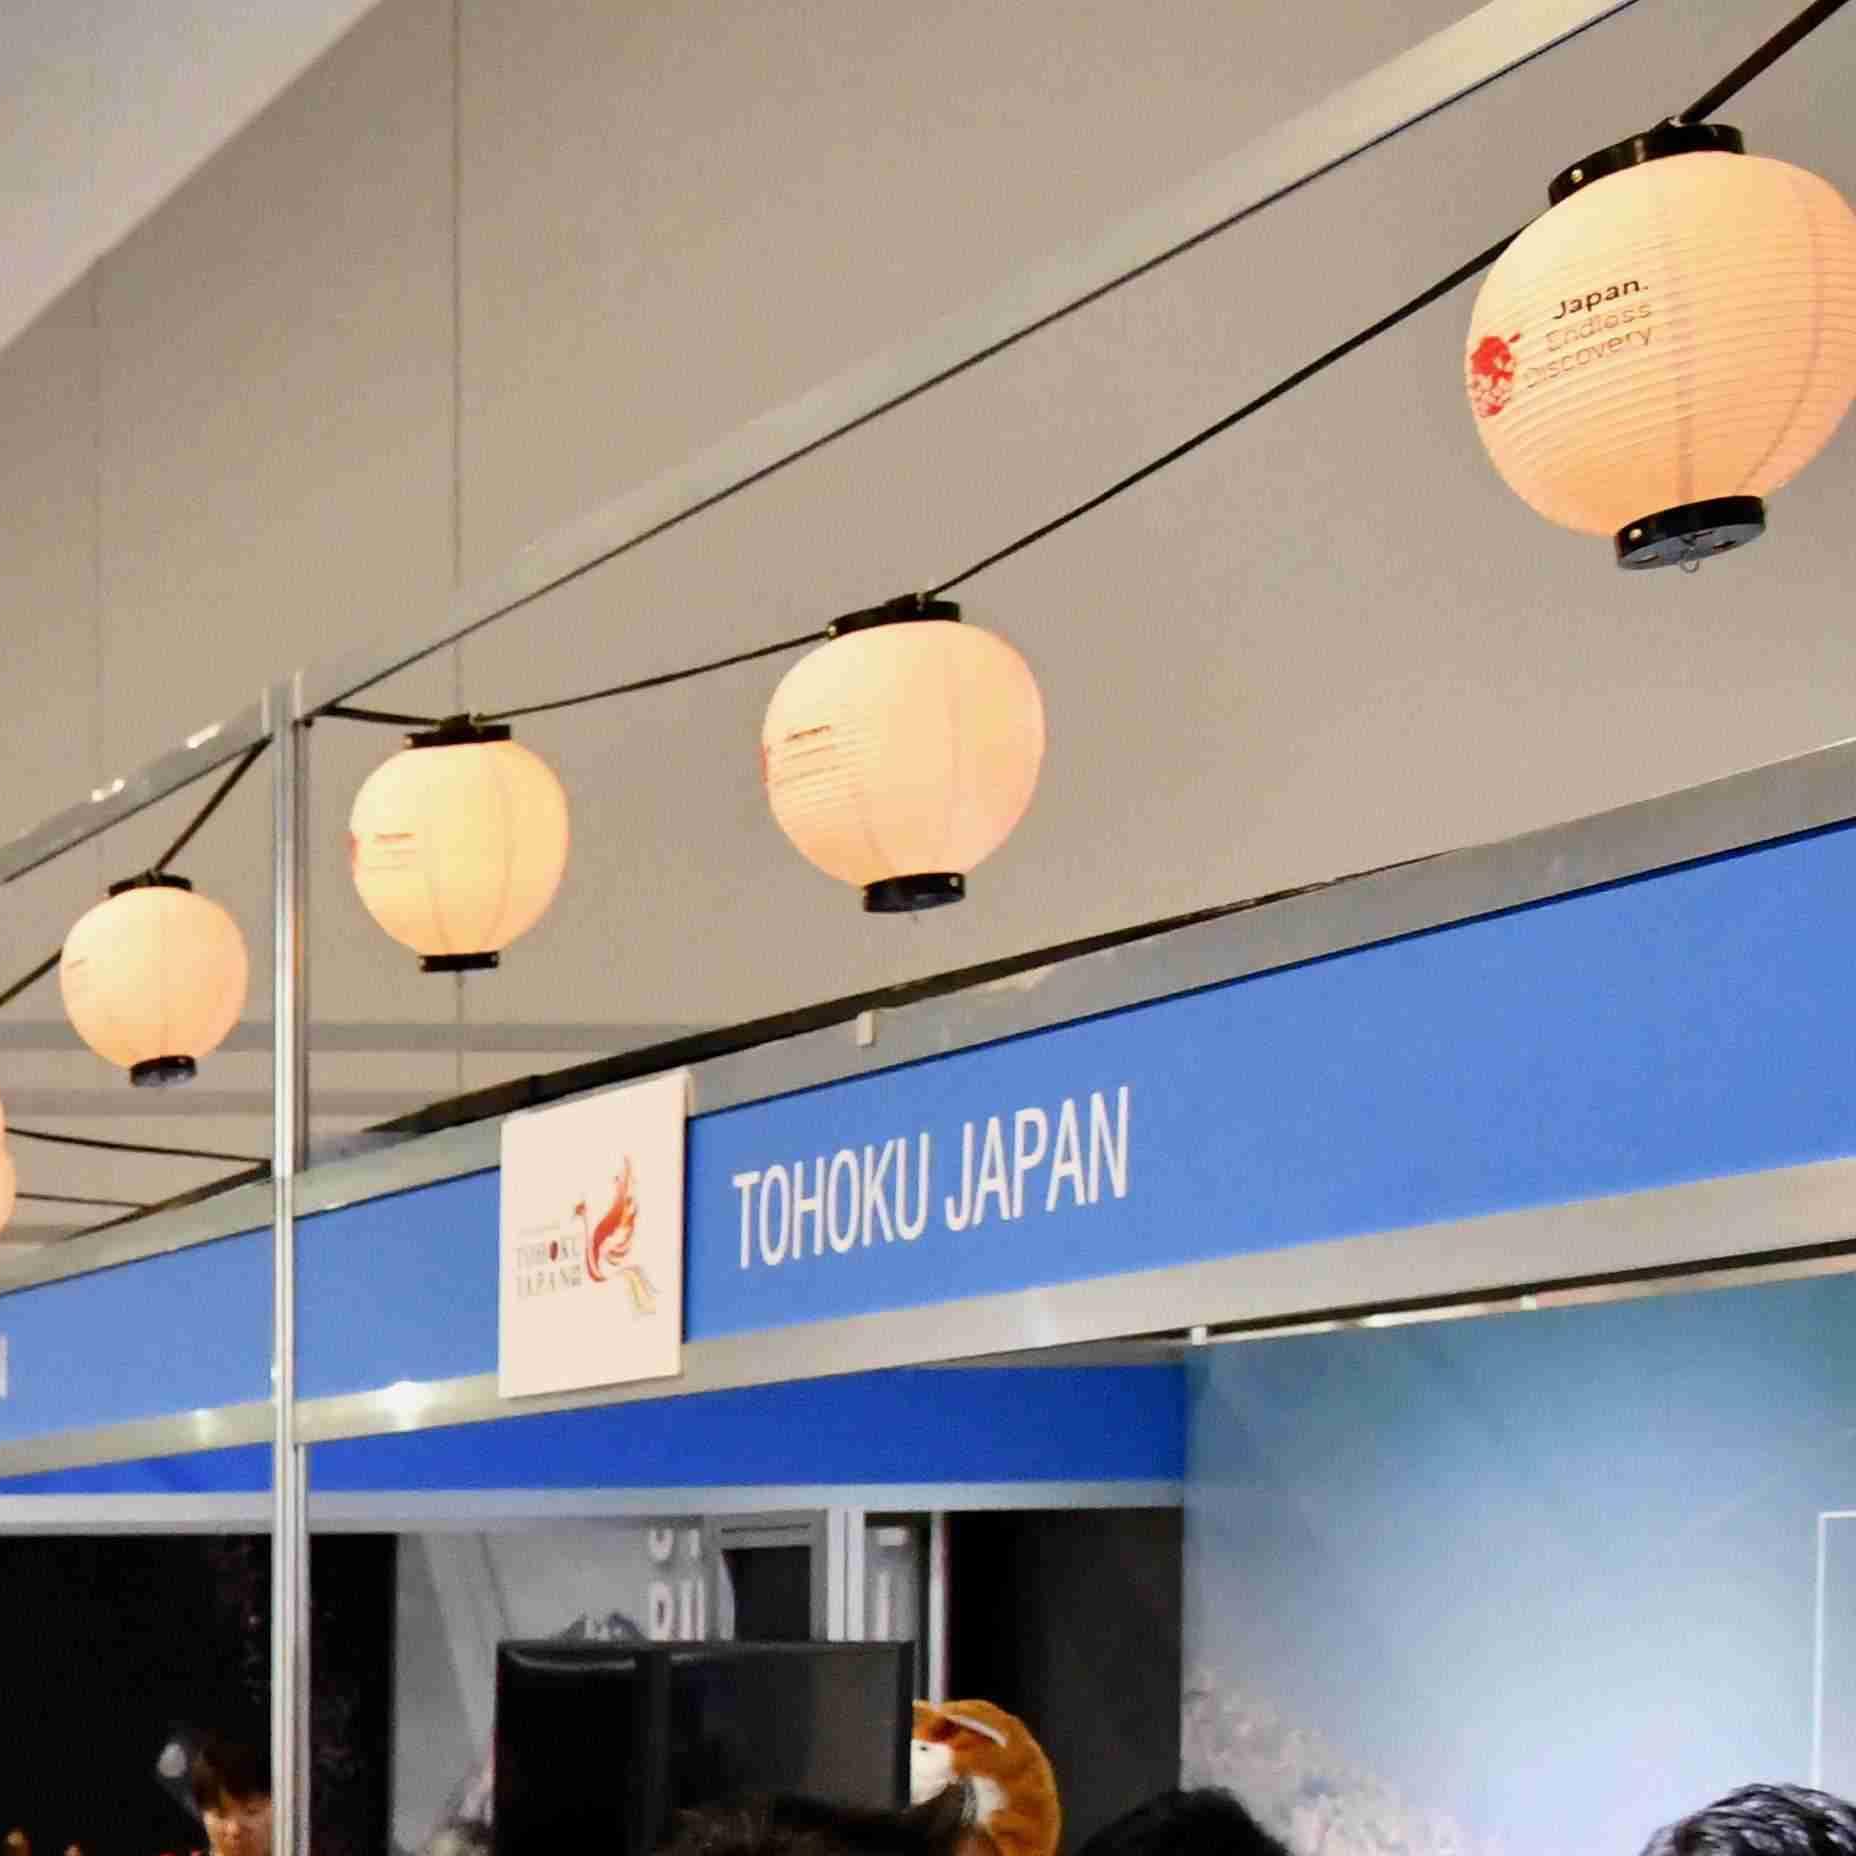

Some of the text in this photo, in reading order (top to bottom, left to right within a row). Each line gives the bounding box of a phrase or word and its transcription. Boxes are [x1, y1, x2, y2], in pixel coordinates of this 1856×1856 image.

[1552, 279, 1649, 320] Japan.
[1545, 303, 1652, 352] Endless
[732, 1085, 1130, 1270] TOHOKU JAPAN
